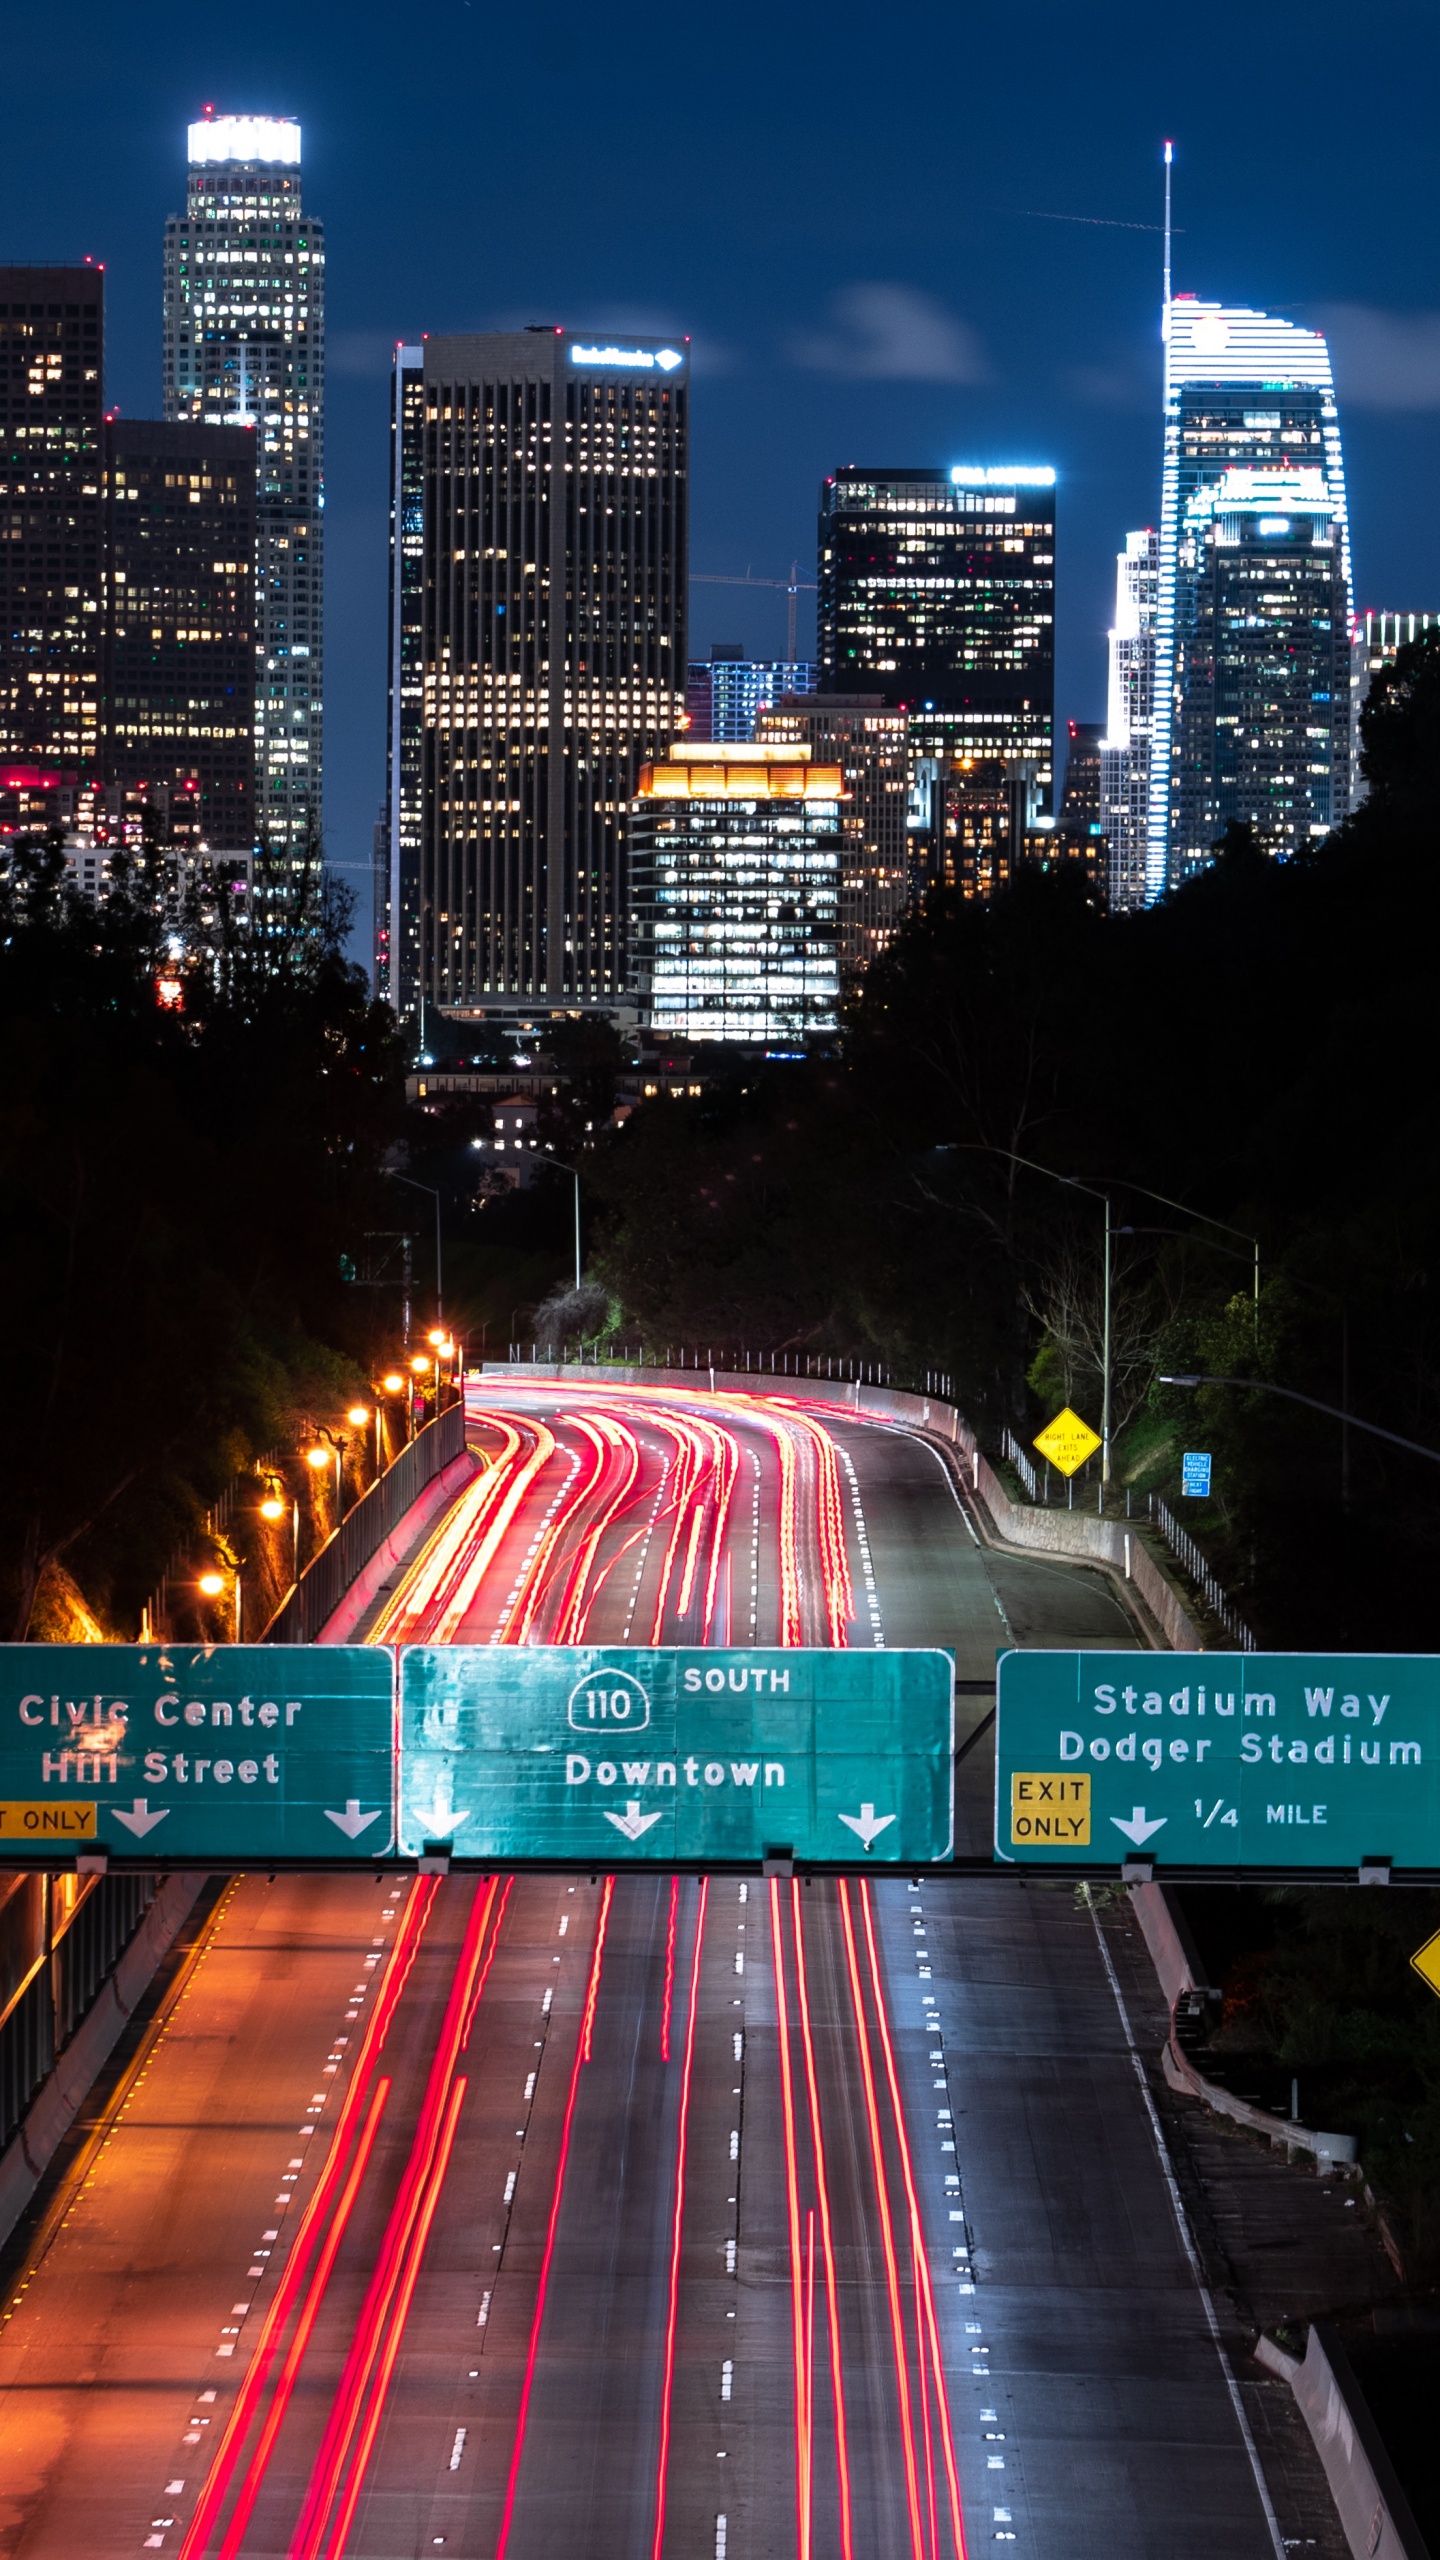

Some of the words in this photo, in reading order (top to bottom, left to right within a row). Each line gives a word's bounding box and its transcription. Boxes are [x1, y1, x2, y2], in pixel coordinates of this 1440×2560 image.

[1045, 1433, 1065, 1441] RIGHT
[1071, 1433, 1090, 1441] LANE
[1058, 1443, 1078, 1452] EXITS
[684, 1668, 790, 1693] SOUTH
[19, 1695, 129, 1726] Civic
[154, 1695, 302, 1727] Center
[586, 1689, 631, 1718] 110
[1093, 1684, 1277, 1716] Stadium
[1304, 1687, 1392, 1726] Way
[1059, 1731, 1212, 1771] Dodger
[1240, 1733, 1423, 1765] Stadium
[41, 1752, 118, 1783] Hill
[143, 1752, 280, 1784] Street
[566, 1754, 786, 1786] Downtown
[1018, 1781, 1085, 1801] EXIT
[23, 1810, 91, 1830] ONLY
[1016, 1816, 1086, 1837] ONLY
[1266, 1805, 1328, 1825] MILE
